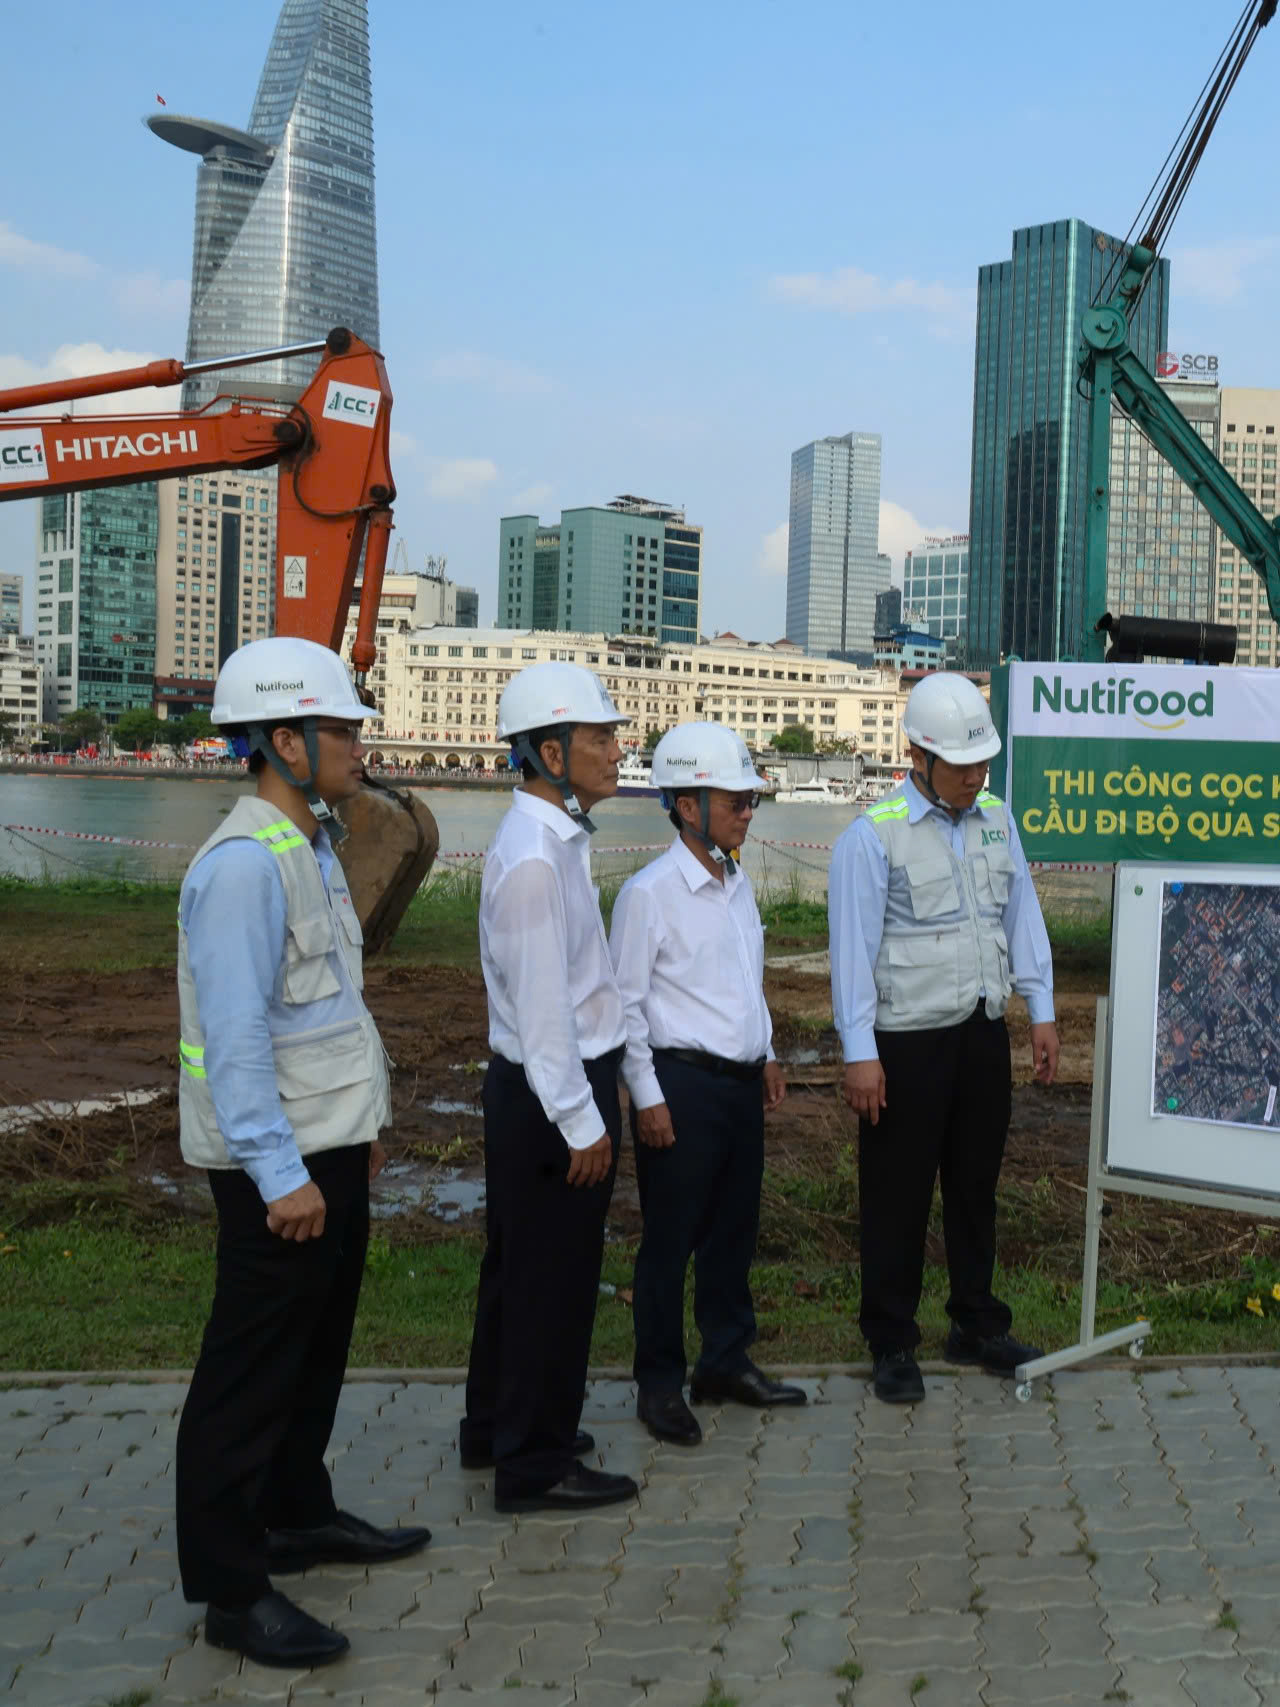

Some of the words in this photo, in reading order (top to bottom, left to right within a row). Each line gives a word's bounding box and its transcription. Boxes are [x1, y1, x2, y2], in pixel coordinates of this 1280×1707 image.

[1182, 354, 1218, 370] SCB
[2, 444, 43, 465] CC1
[55, 430, 198, 462] HITACHI
[255, 680, 304, 693] Nutifood
[1032, 675, 1214, 717] Nutifood
[666, 758, 697, 767] Nutifood
[1043, 769, 1095, 796] THI
[1103, 764, 1192, 798] CÔNG
[1200, 773, 1264, 806] CỌC
[1022, 797, 1087, 834] CẦU
[1095, 809, 1127, 835] ĐI
[1135, 803, 1180, 844] BỘ
[1187, 811, 1254, 842] QUA
